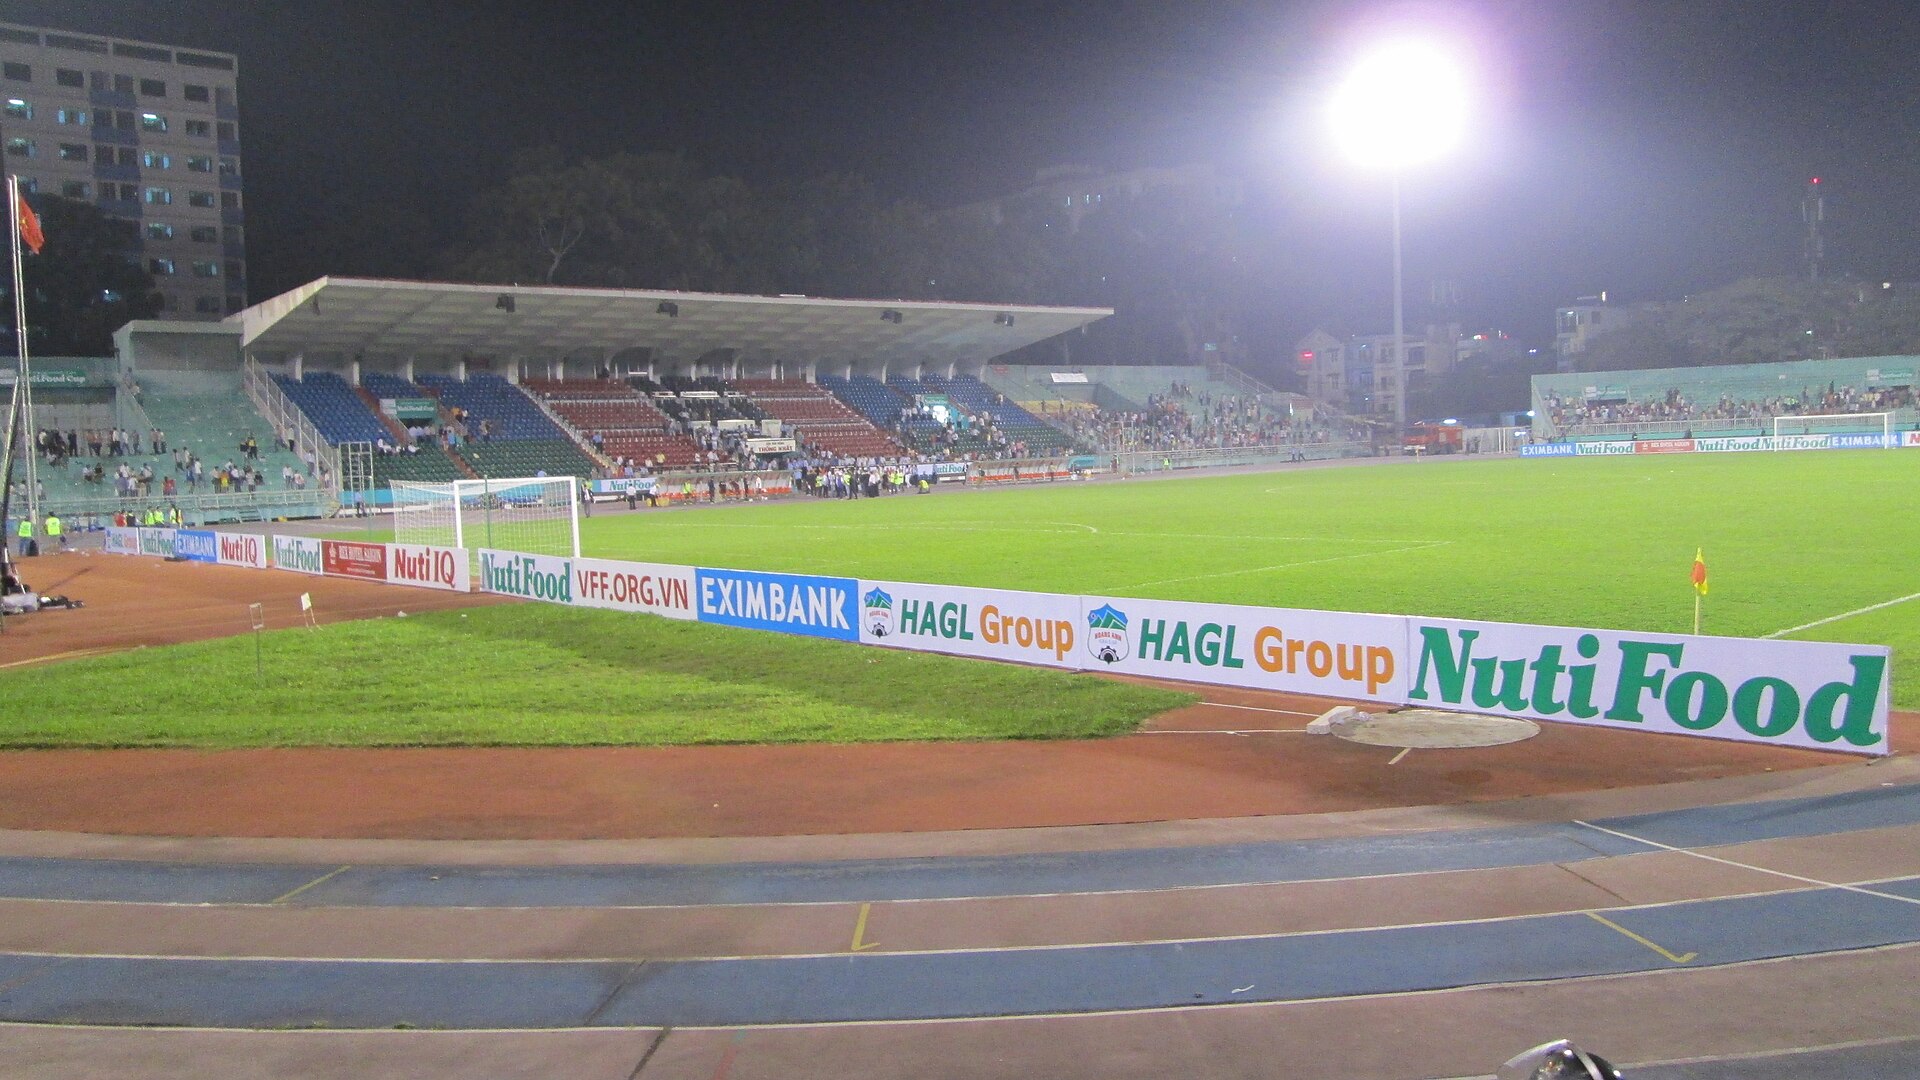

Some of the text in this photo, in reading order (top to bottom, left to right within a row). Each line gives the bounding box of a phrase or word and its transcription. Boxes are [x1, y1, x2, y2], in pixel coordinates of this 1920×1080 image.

[1522, 444, 1573, 455] EXIMBANK
[1576, 442, 1634, 454] NutiFood
[1832, 435, 1898, 446] EXIMBANK
[221, 535, 258, 566] Nuti IQ
[275, 538, 321, 573] NutiFood
[394, 547, 456, 588] Nuti IQ
[481, 553, 572, 602] NutiFood
[577, 570, 689, 610] VFF.ORG.VN
[701, 577, 850, 630] EXIMBANK
[900, 599, 1074, 661] HAGL Group
[1138, 618, 1394, 695] HAGL Group
[1408, 626, 1888, 747] NutiFood
